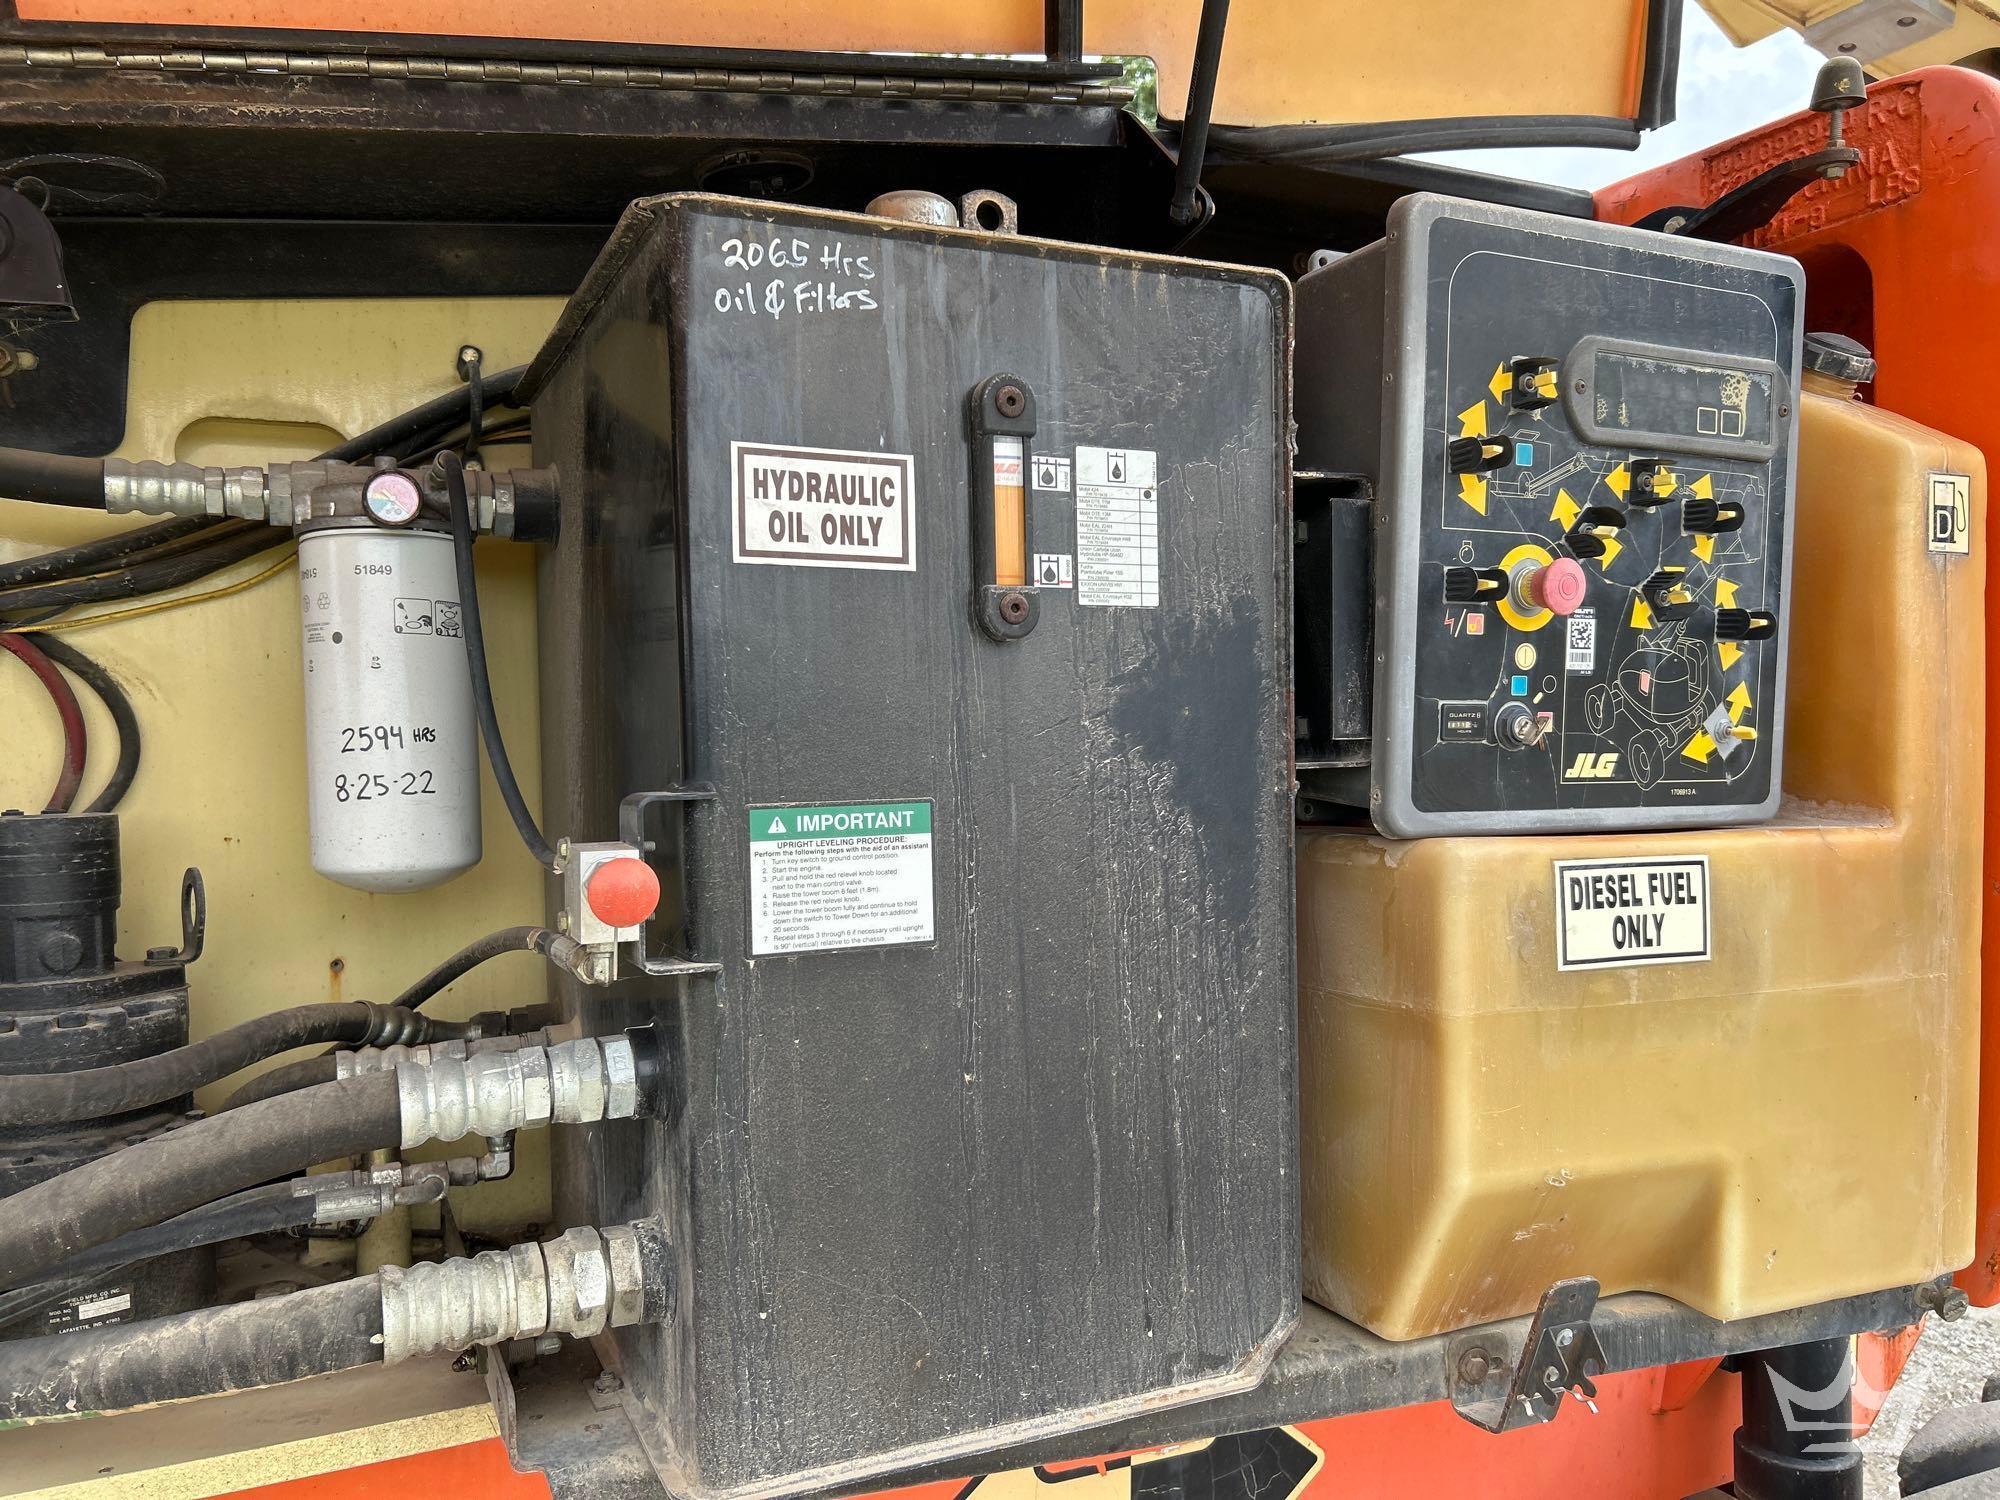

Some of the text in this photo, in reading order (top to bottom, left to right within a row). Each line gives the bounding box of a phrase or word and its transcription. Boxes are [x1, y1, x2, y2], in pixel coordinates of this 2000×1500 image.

[721, 238, 810, 271] 2065
[753, 467, 896, 508] HYDRAULIC
[768, 510, 883, 547] OIL ONLY
[1936, 510, 1952, 538] D
[354, 564, 392, 575] 51849
[341, 726, 436, 753] 2594 HRS
[1565, 753, 1619, 778] JLG
[796, 810, 914, 833] IMPORTANT
[777, 836, 908, 849] UPRIGHT LEVELING PROCEDURE:
[795, 848, 825, 856] following
[827, 846, 844, 854] steps
[901, 842, 929, 850] assistant
[829, 854, 850, 863] ground
[876, 868, 898, 876] located
[1570, 871, 1697, 911] DIESEL FUEL
[889, 908, 918, 916] additional
[774, 934, 796, 942] Repeat
[822, 930, 845, 938] through
[858, 927, 888, 935] necessary
[903, 924, 924, 932] upright
[1612, 913, 1665, 950] ONLY
[793, 941, 818, 949] (vertical)
